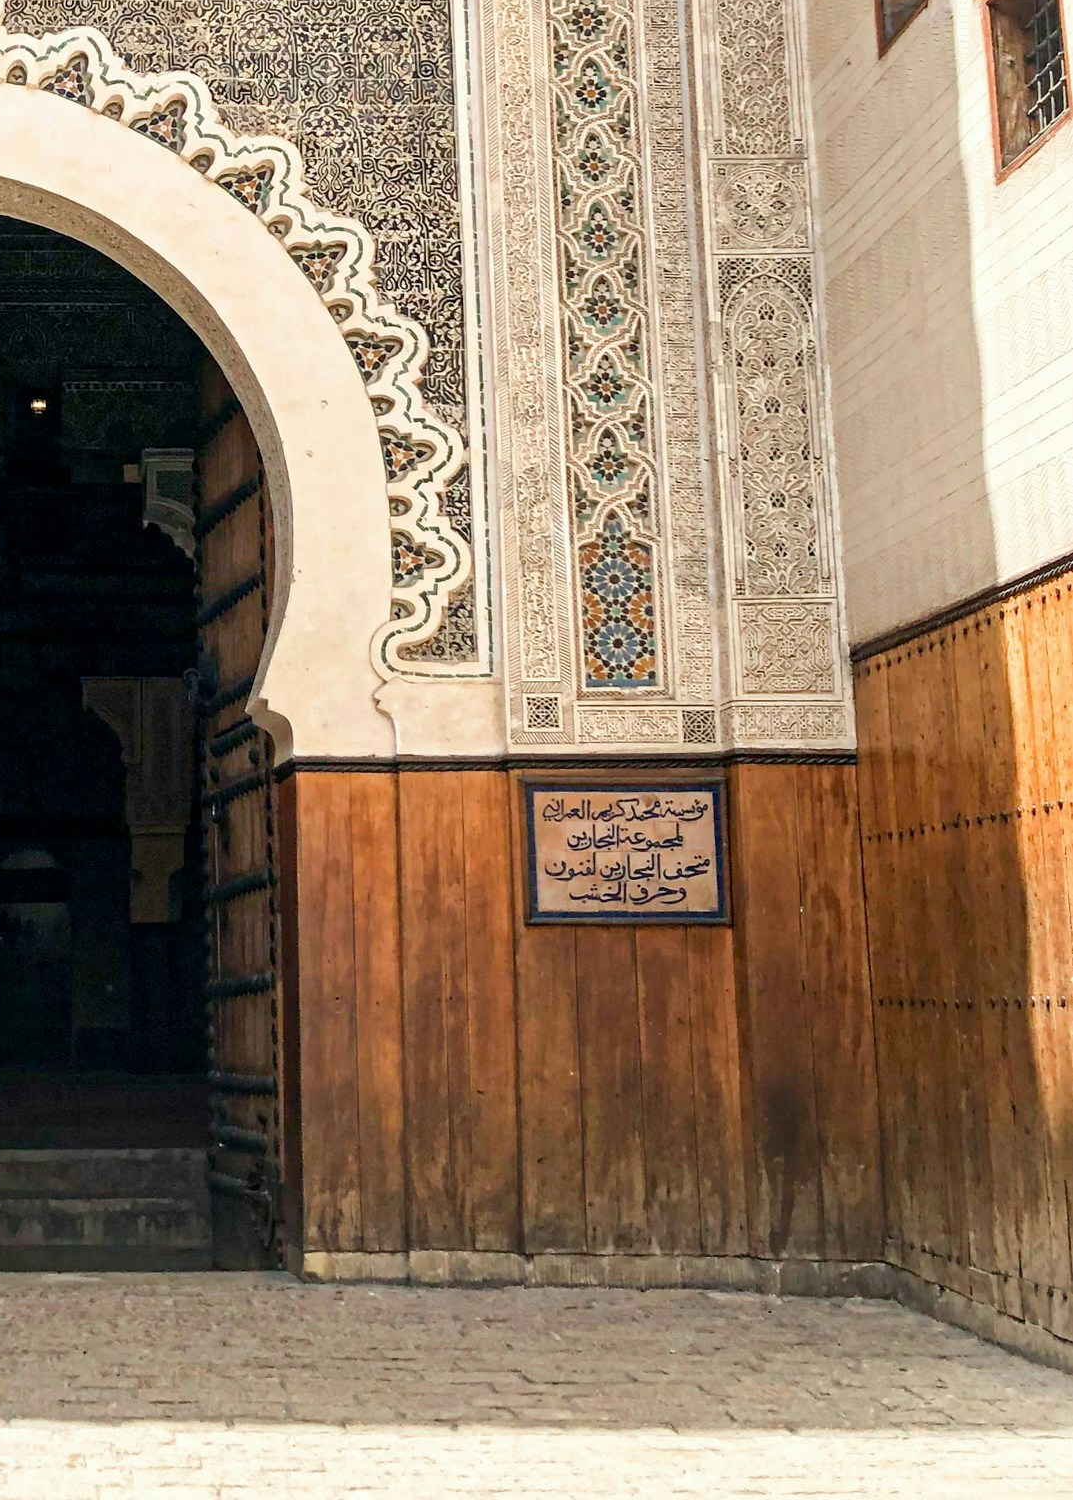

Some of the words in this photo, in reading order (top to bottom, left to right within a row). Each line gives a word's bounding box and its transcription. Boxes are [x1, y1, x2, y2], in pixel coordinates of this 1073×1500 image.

[542, 798, 591, 822] العمراني
[591, 798, 639, 822] كريم
[628, 800, 662, 822] محمد
[662, 798, 709, 822] مؤسسة
[567, 823, 620, 851] النجارين
[619, 823, 684, 852] لمجموعة
[544, 851, 596, 880] لفنون
[600, 853, 661, 881] النجارين
[663, 854, 710, 880] متحف
[569, 880, 627, 904] الخشب
[628, 883, 687, 905] وحرف
